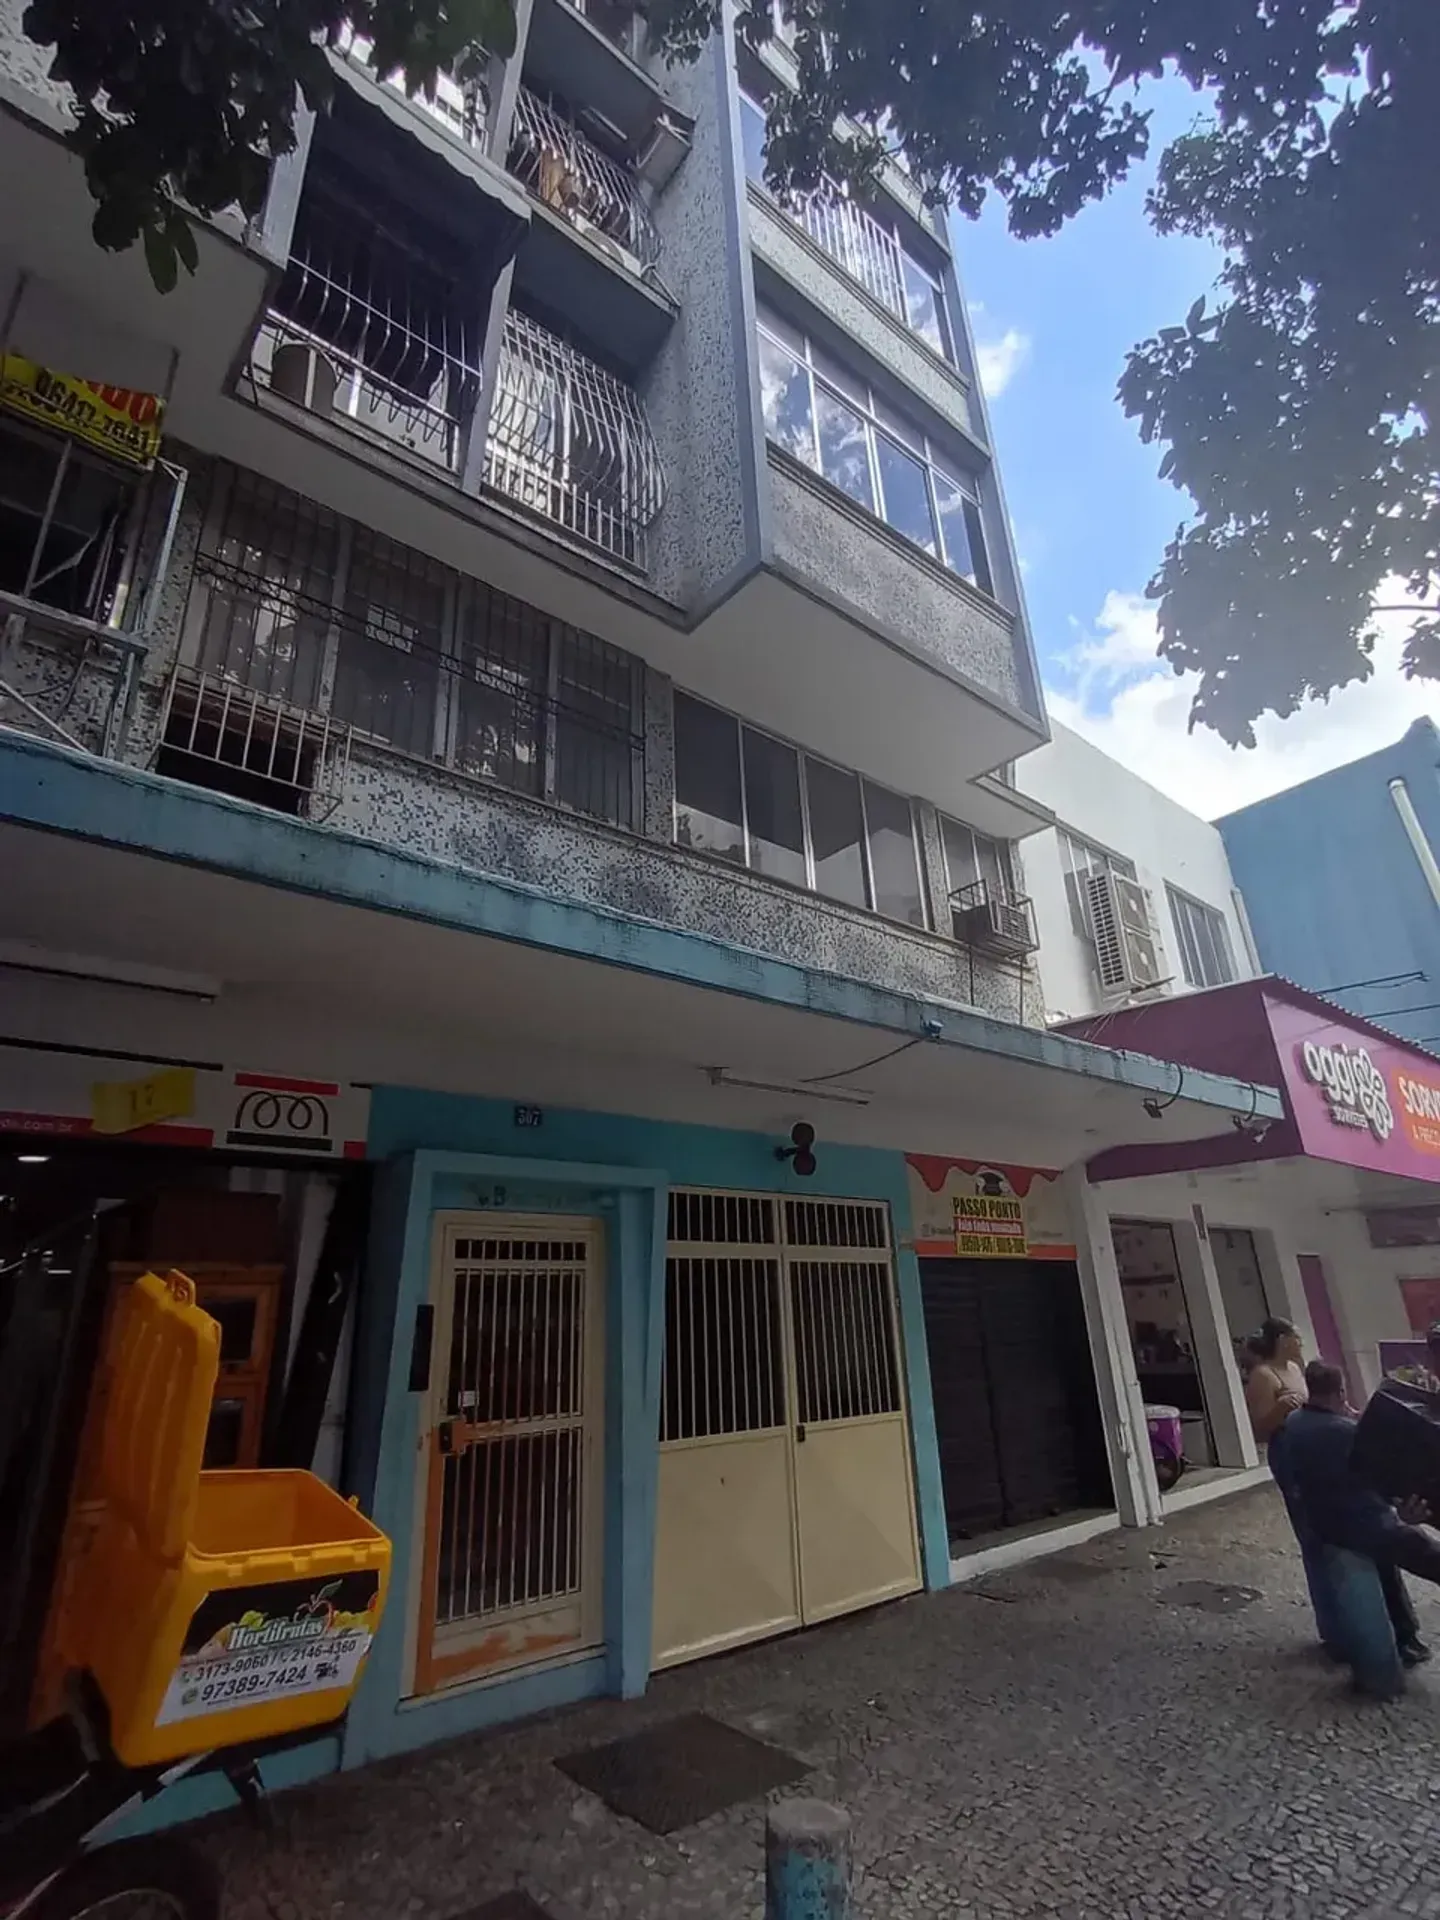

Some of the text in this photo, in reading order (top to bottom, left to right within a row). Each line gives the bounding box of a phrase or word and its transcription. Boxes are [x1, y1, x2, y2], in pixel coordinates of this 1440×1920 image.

[952, 1196, 1021, 1219] PASSO PONTO
[227, 1618, 323, 1651] Hortifrutas
[201, 1665, 308, 1701] 97389-7424
